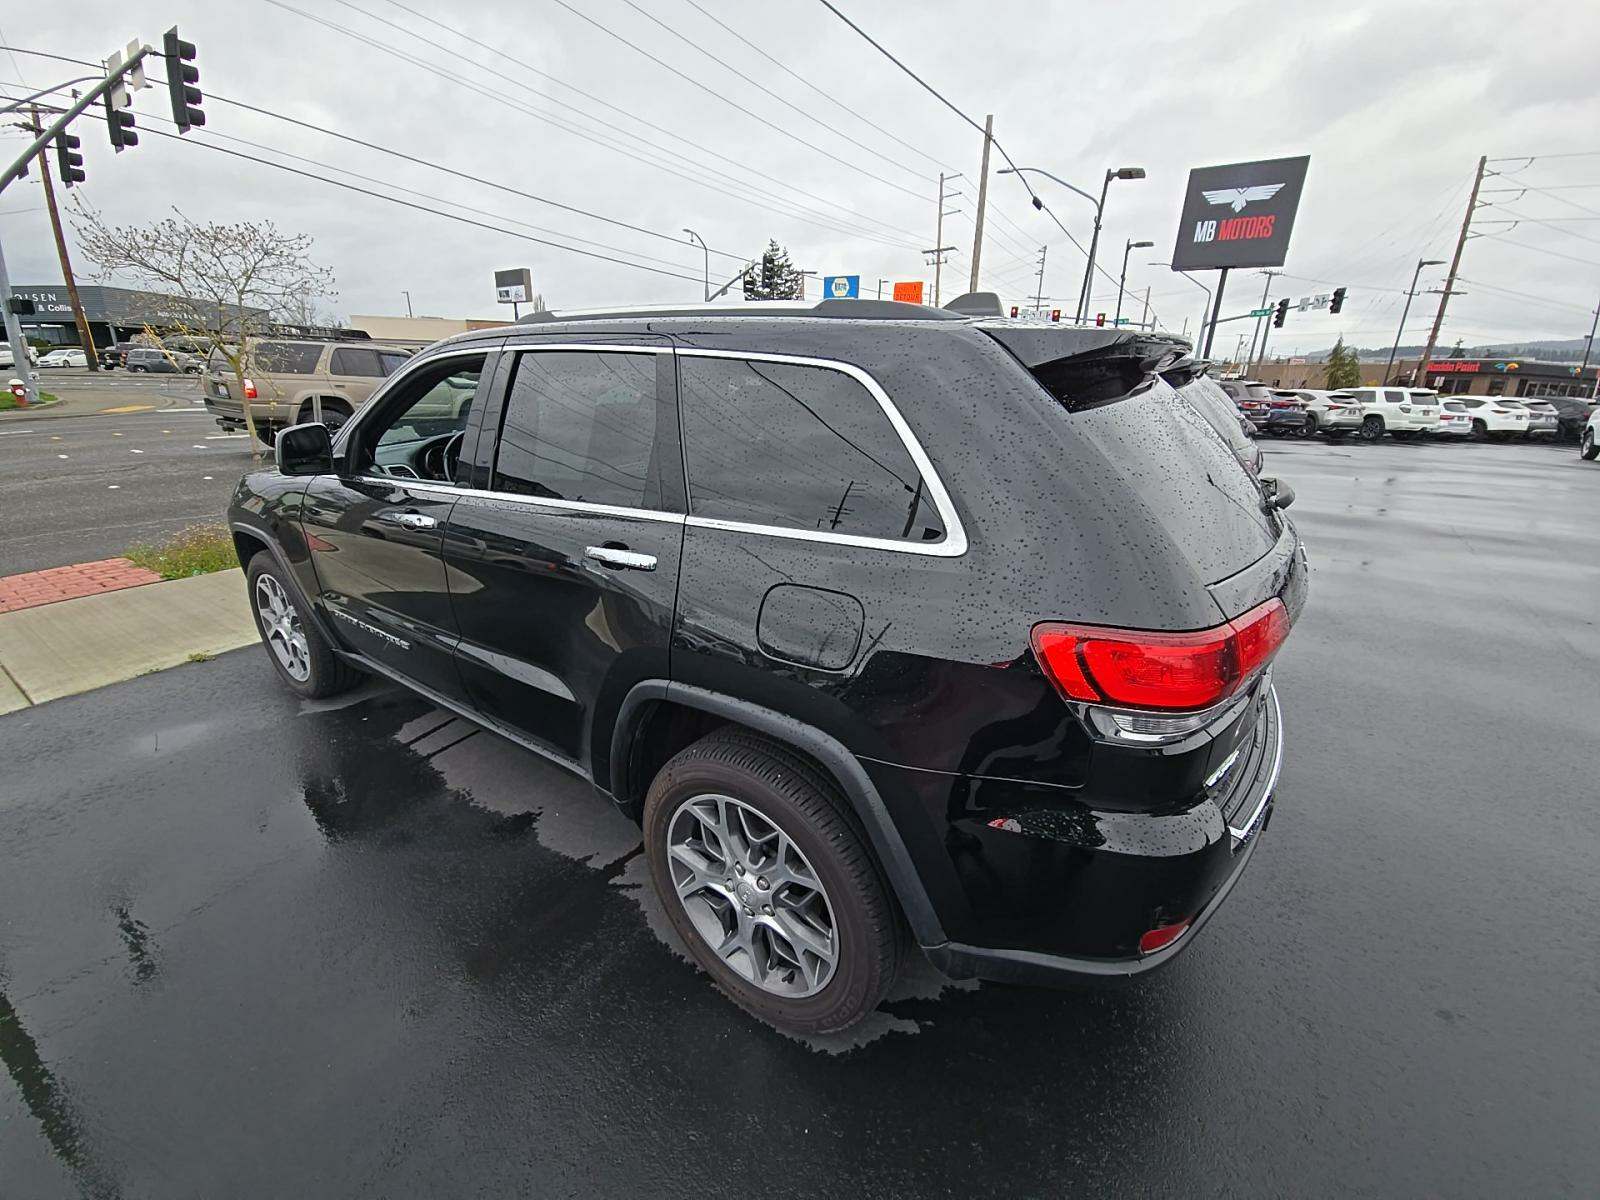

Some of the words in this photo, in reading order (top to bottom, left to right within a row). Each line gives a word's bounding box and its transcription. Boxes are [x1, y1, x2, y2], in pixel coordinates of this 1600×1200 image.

[1193, 220, 1217, 243] MB
[1218, 215, 1276, 241] MOTORS
[47, 304, 86, 312] Collisn
[1455, 361, 1480, 373] Paint
